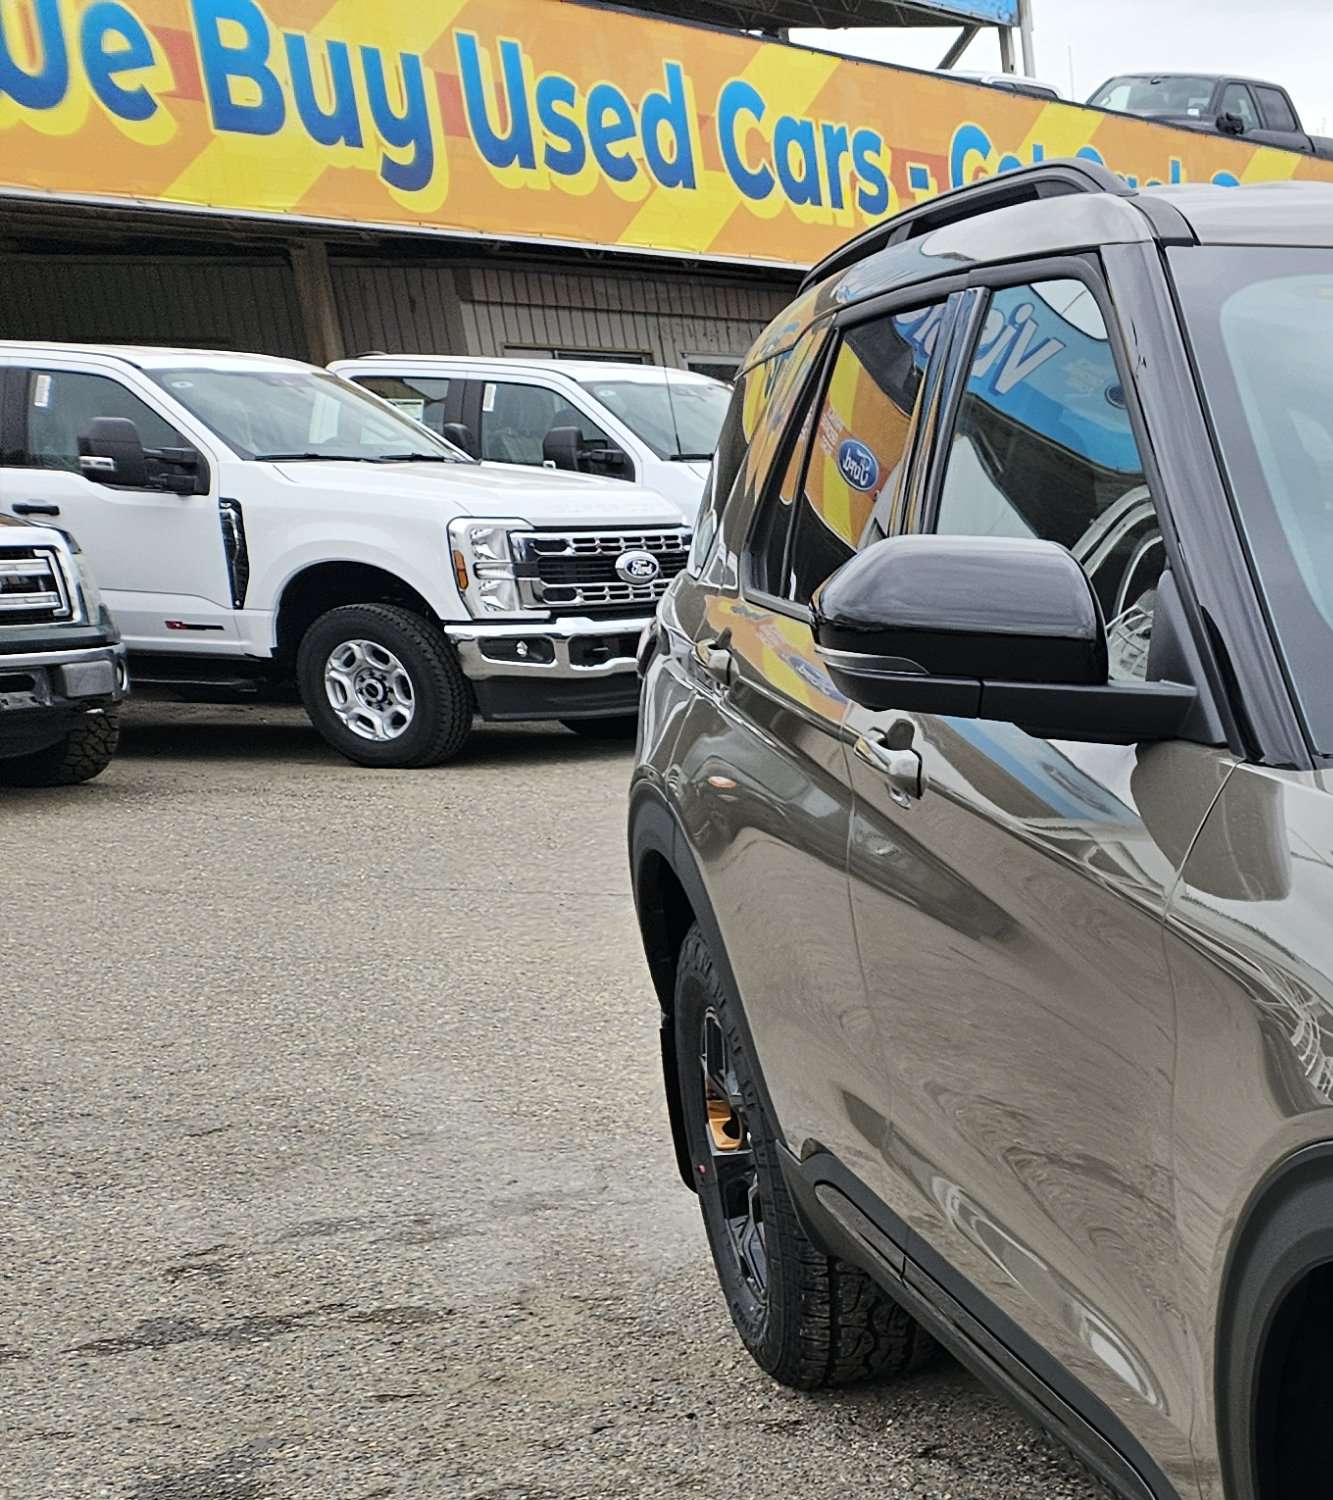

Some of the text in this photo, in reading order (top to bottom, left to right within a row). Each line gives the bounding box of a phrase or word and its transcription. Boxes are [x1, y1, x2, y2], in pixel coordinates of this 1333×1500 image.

[190, 0, 434, 192] Buy
[455, 32, 696, 189] Used
[718, 80, 889, 216] Cars
